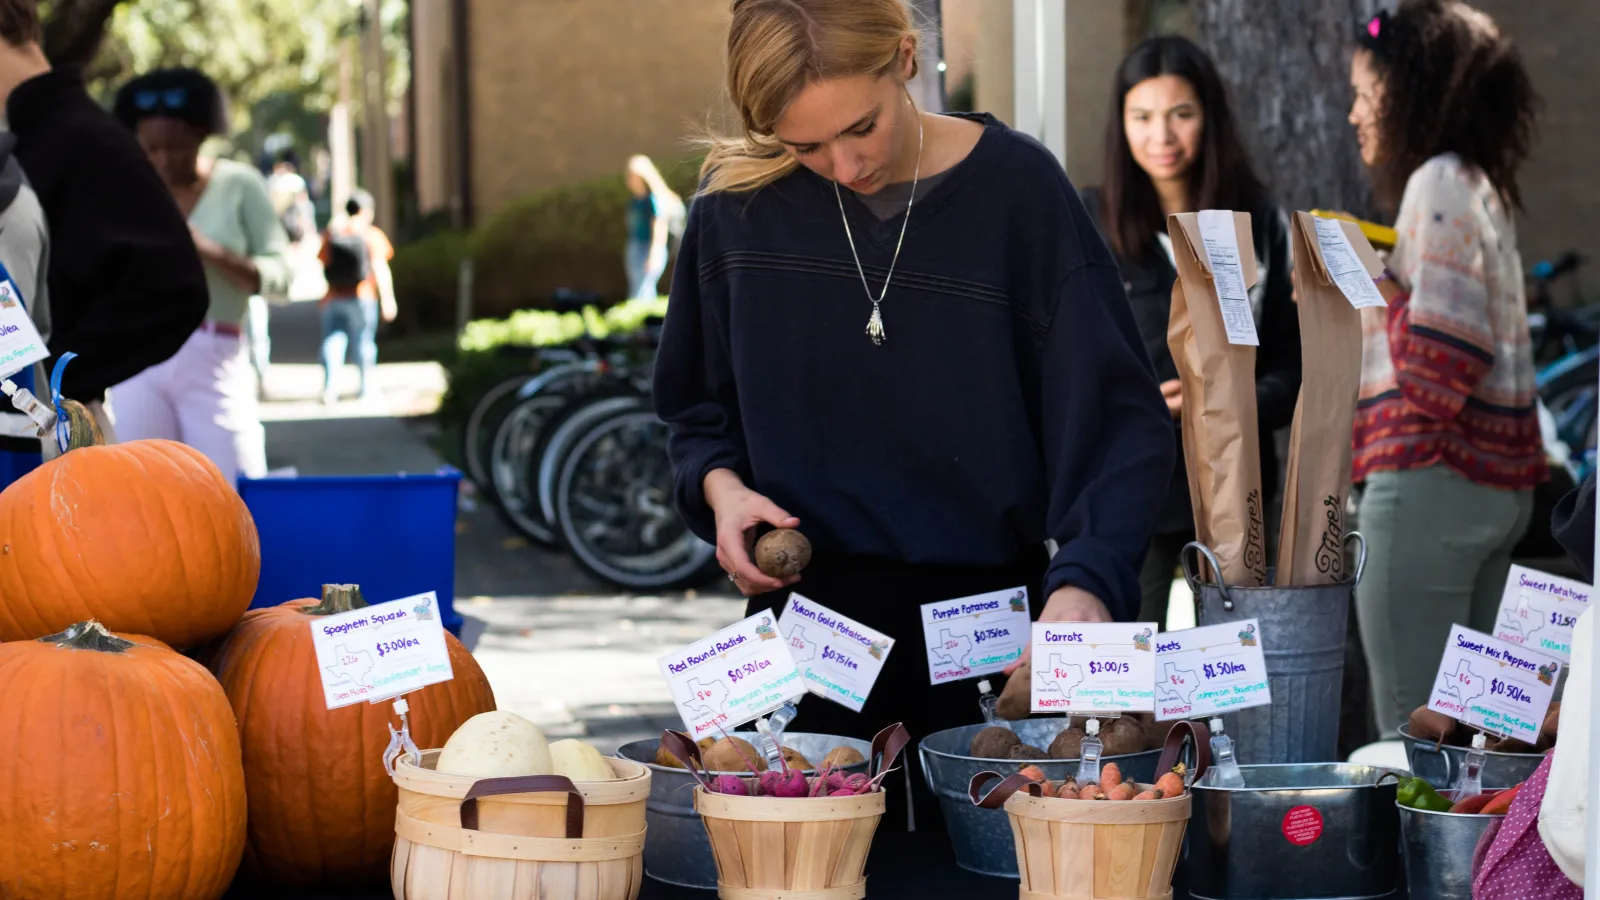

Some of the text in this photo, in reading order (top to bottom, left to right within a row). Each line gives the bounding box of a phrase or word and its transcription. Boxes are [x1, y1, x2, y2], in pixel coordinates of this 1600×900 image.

[1244, 488, 1262, 569] Tiger
[1315, 494, 1343, 573] Tiger
[1518, 573, 1588, 602] Sweet Potatoes
[323, 609, 406, 636] Spaghetti Squash
[791, 599, 872, 646] Yukon Gold Potatoes
[932, 600, 999, 619] Purple Potatoes
[973, 628, 1009, 643] $0.75/ea
[1045, 630, 1082, 642] Carrots
[668, 634, 747, 674] Red Round Radish
[821, 644, 857, 669] $0.75/ea
[1456, 633, 1536, 670] Sweet Mix Peppers
[727, 659, 771, 683] $0.50/ea
[1088, 660, 1129, 674] $2.00/5
[1202, 661, 1246, 679] $1.50/ea
[1490, 677, 1530, 703] $0.50/ea
